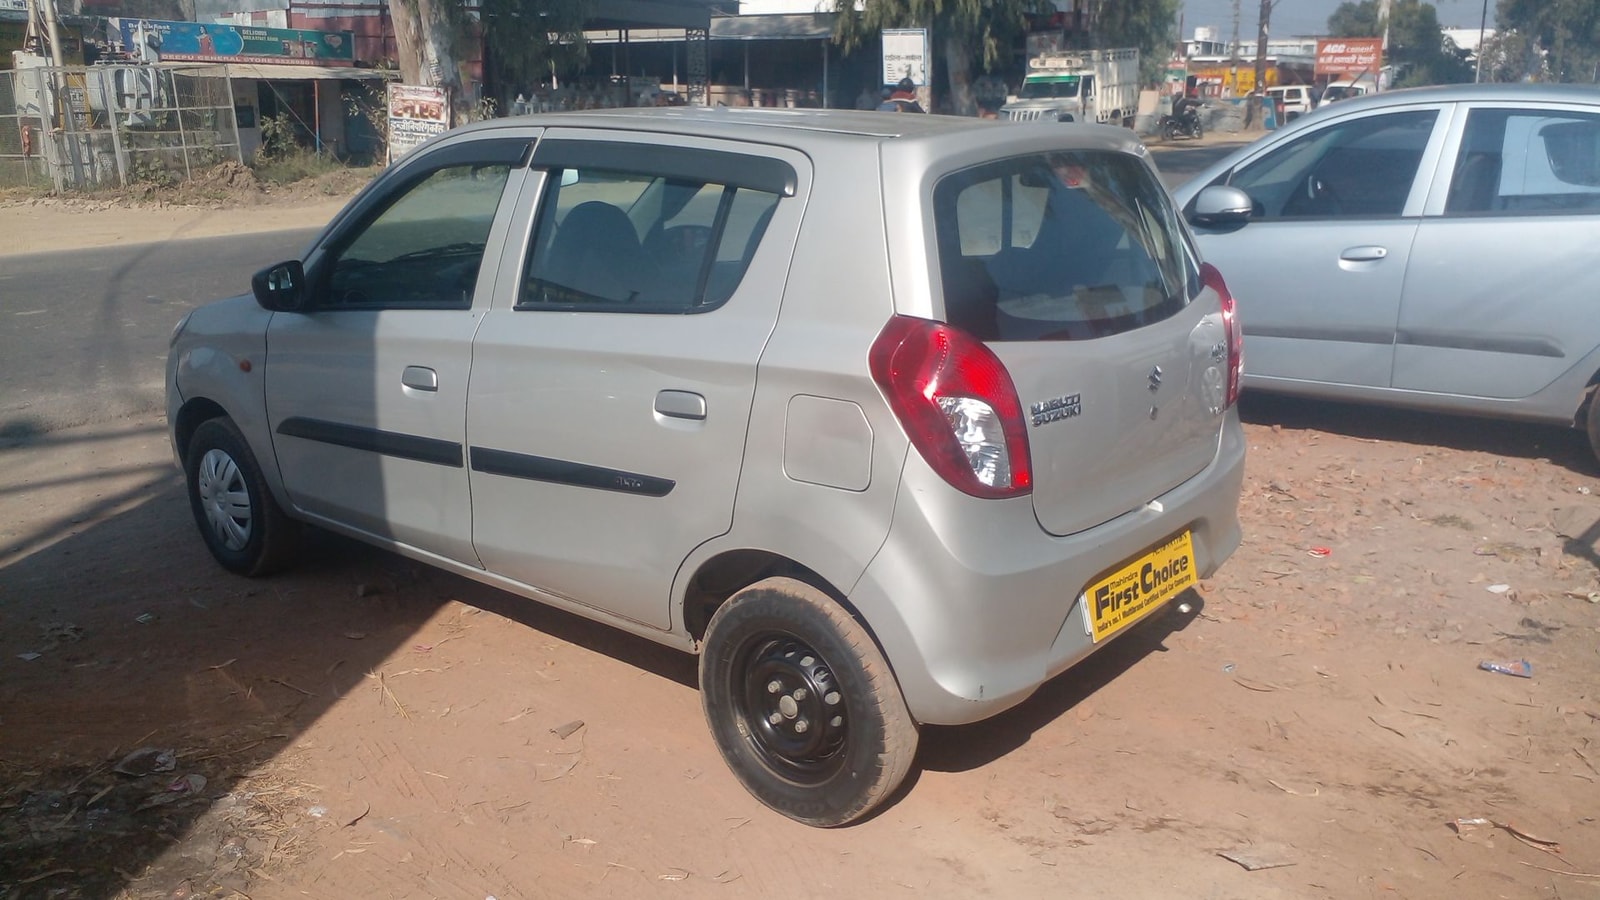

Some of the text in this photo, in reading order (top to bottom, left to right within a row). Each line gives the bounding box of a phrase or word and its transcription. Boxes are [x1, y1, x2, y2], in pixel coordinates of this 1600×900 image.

[1346, 45, 1374, 53] cement
[1031, 393, 1080, 415] MARUTI
[1032, 403, 1081, 427] SUZUKI
[1095, 555, 1188, 620] First Choice
[1110, 572, 1138, 590] Mahindra
